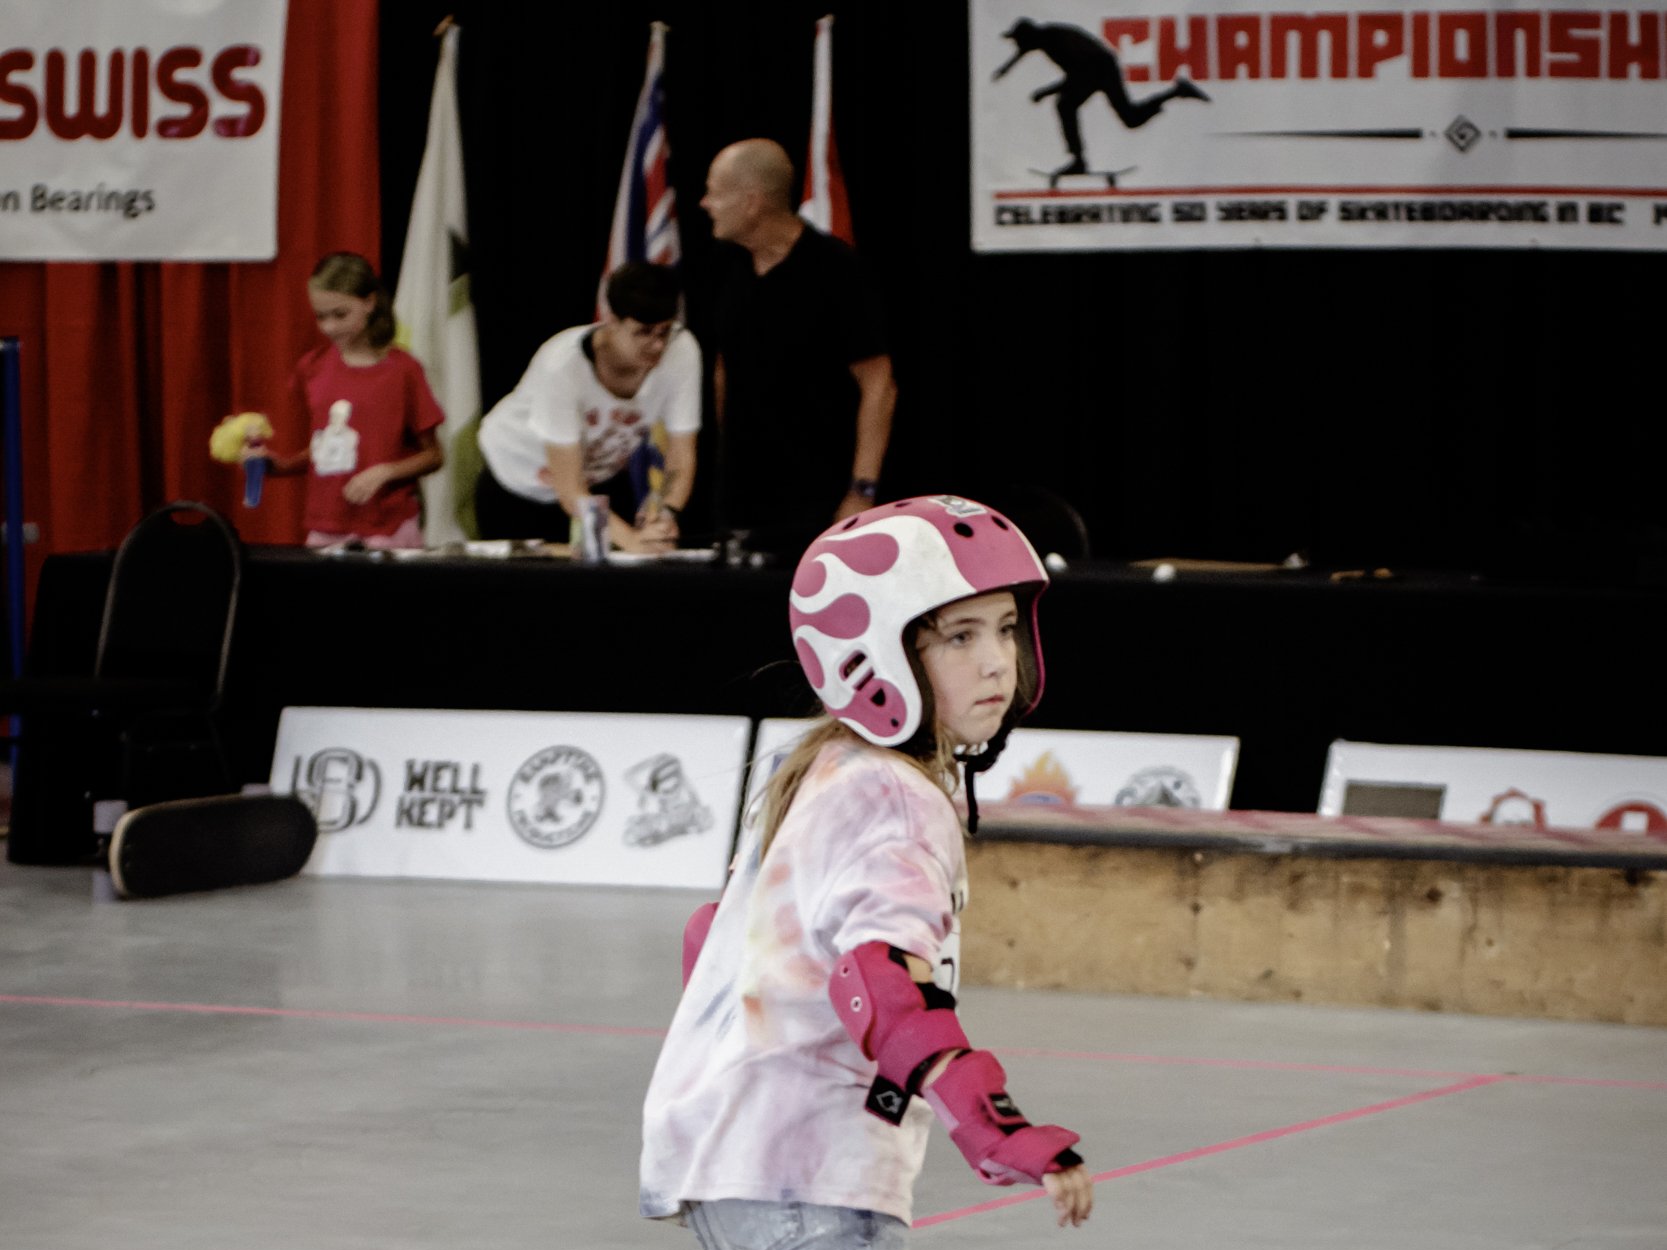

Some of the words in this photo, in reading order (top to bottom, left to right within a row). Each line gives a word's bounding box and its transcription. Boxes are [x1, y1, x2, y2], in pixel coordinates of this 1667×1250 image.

[1102, 10, 1667, 83] CHAMPIONSH
[0, 46, 266, 141] SWISS
[30, 182, 156, 220] Bearings
[994, 202, 1161, 226] CELEBRATING
[1215, 200, 1288, 222] YEARS
[1297, 200, 1329, 222] OF
[1338, 200, 1550, 223] SKATEBOARDING
[404, 758, 488, 795] WELL
[394, 795, 486, 831] KEPT
